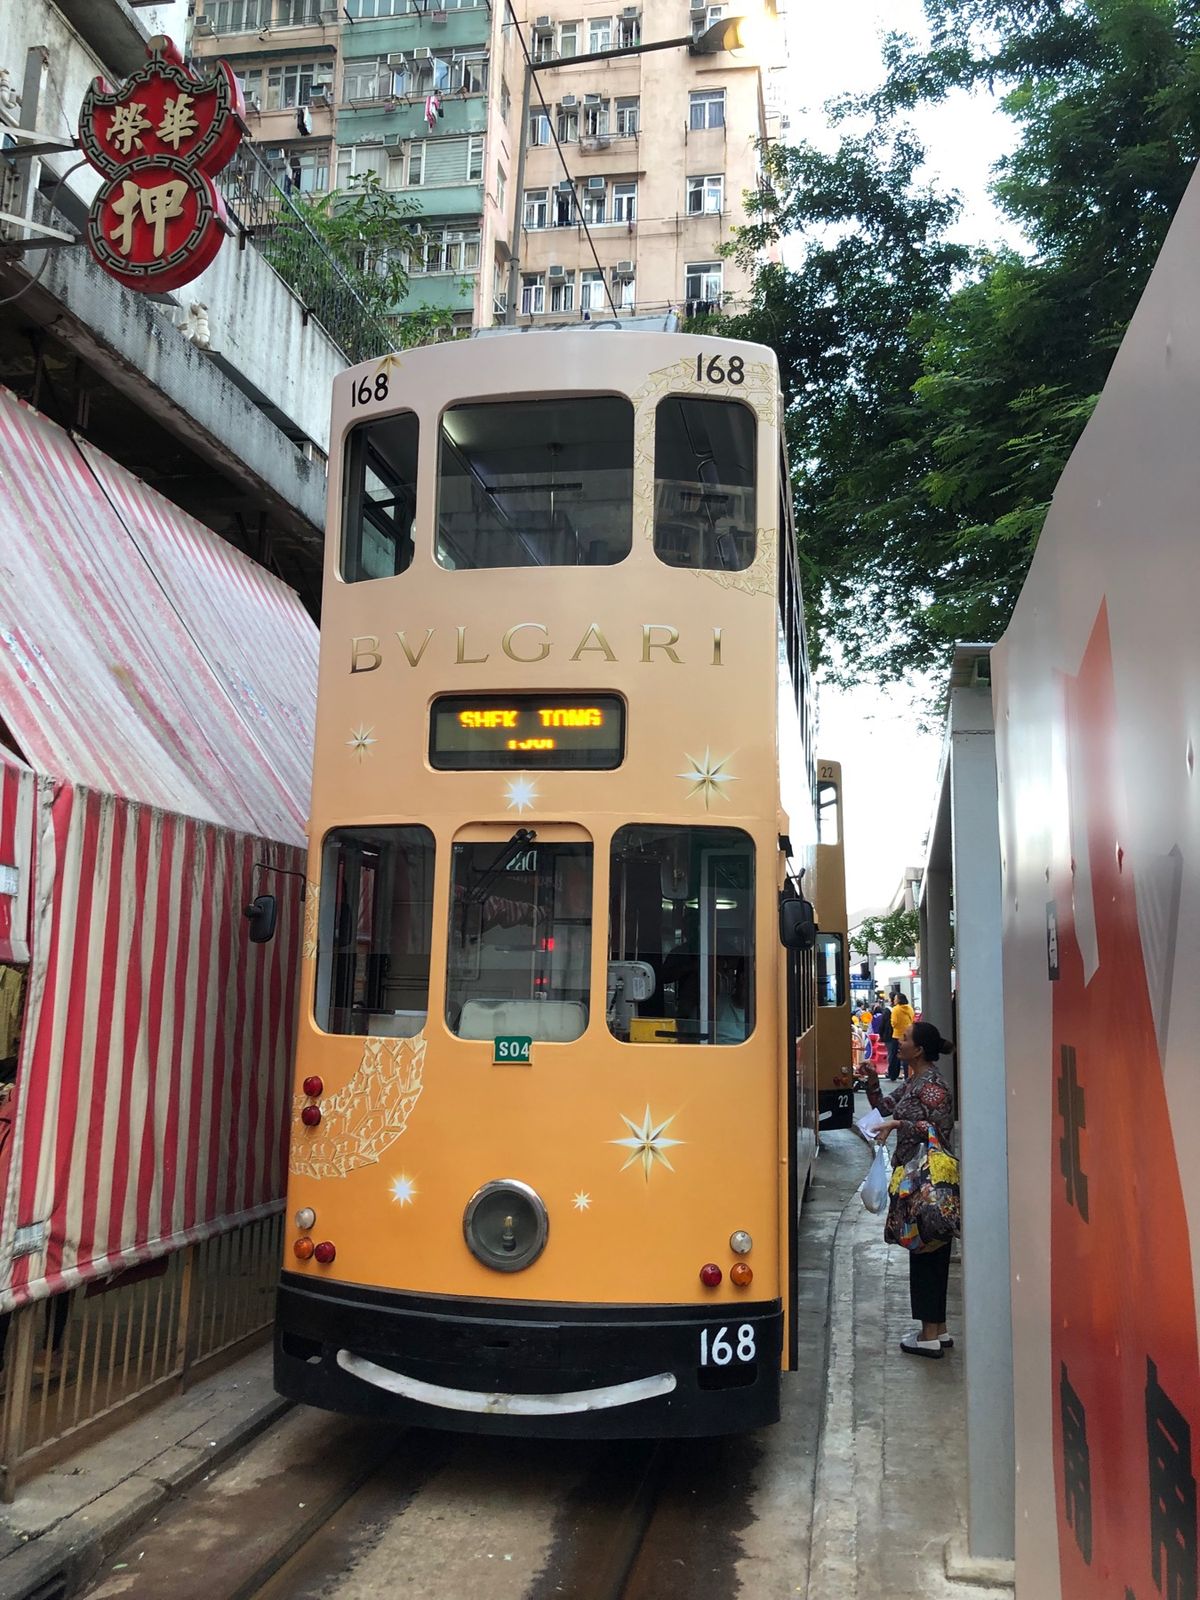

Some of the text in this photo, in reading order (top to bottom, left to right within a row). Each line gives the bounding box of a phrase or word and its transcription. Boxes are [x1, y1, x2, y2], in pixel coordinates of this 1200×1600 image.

[110, 179, 189, 258] 押
[696, 352, 745, 385] 168
[351, 373, 390, 407] 168
[349, 622, 727, 674] BVLGARI
[820, 766, 834, 778] 22
[838, 1095, 849, 1108] 22
[699, 1323, 757, 1366] 168
